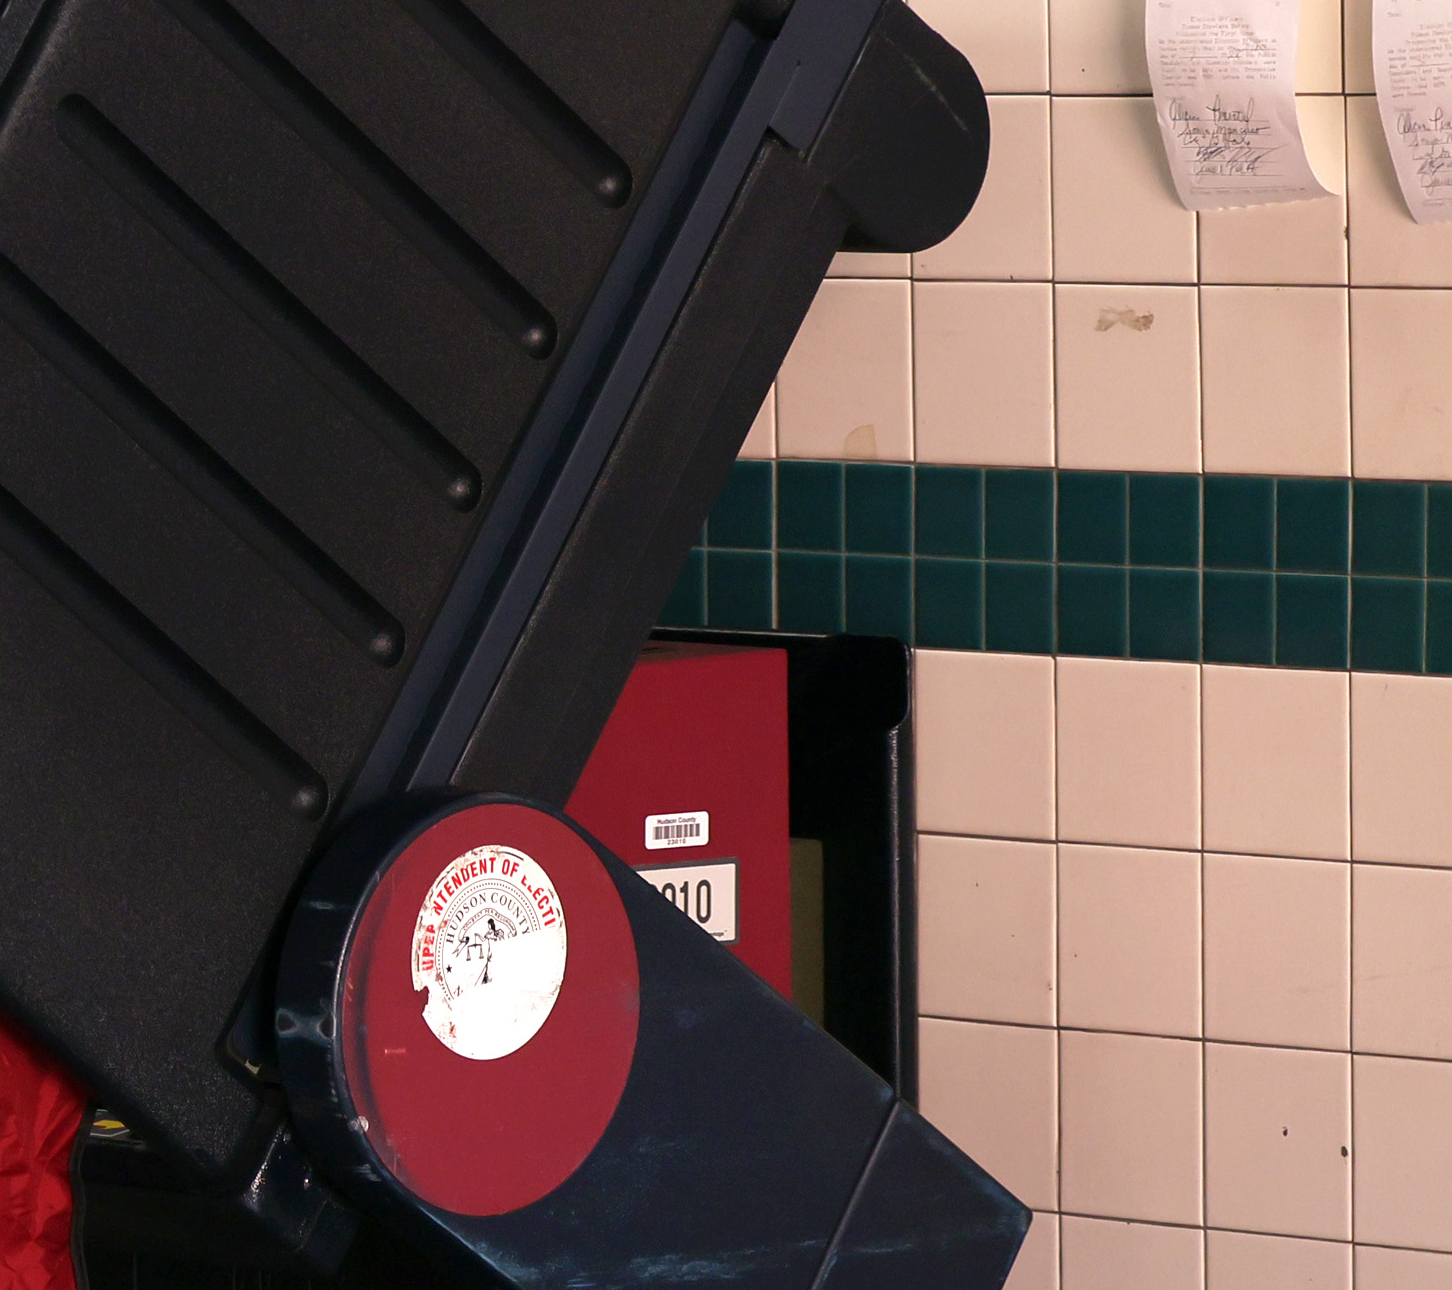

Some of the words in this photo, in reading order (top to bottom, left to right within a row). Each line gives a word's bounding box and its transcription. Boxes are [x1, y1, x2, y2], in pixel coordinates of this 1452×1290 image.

[501, 858, 520, 877] OF
[445, 892, 487, 944] HUDSON
[490, 892, 531, 935] COUNTY
